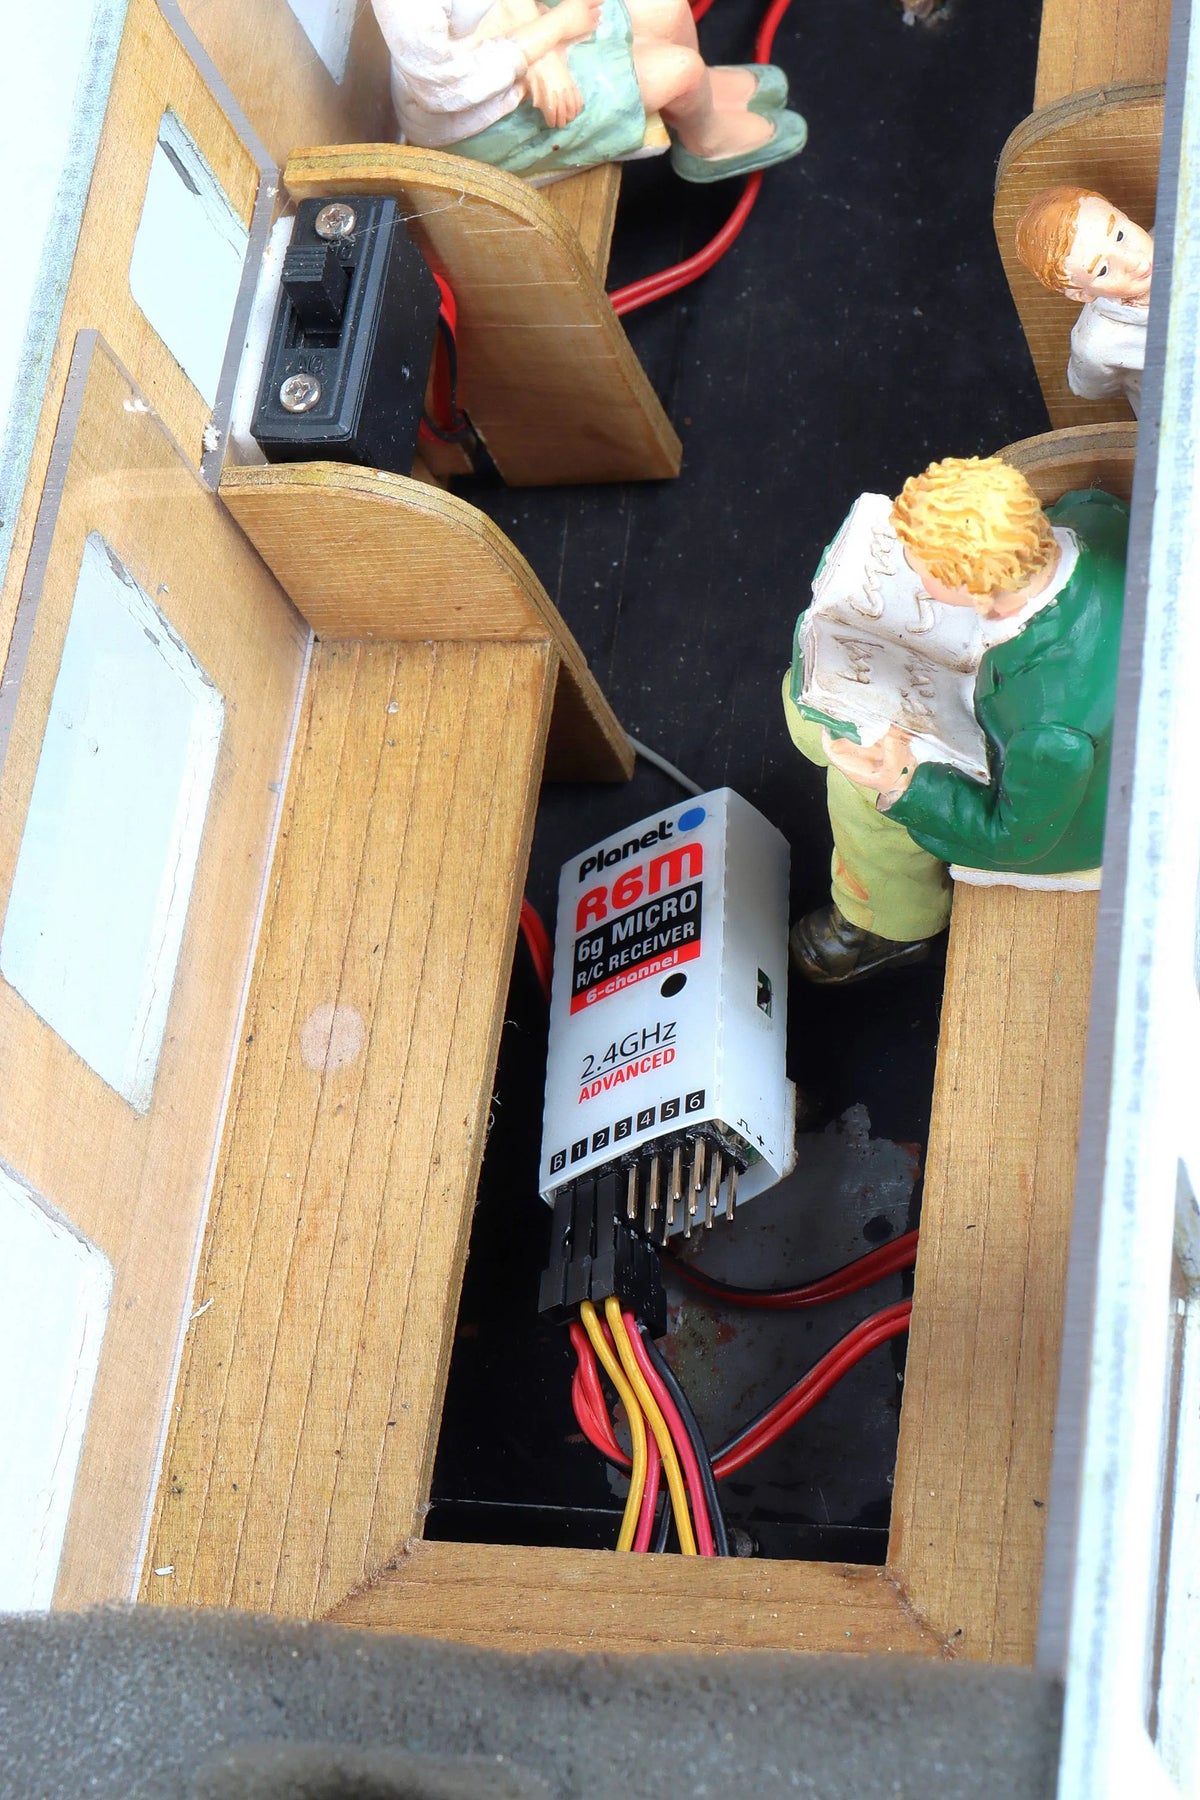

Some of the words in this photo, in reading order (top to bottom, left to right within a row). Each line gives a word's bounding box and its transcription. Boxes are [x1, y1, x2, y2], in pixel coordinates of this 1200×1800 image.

[578, 820, 673, 883] Planet
[576, 962, 604, 989] R/C
[608, 921, 695, 972] RECEIVER
[577, 936, 604, 962] 6g
[611, 889, 698, 945] MICRO
[586, 950, 679, 1004] 6-channel
[577, 1047, 676, 1104] ADVANCED
[580, 1021, 677, 1080] 2.4GHz
